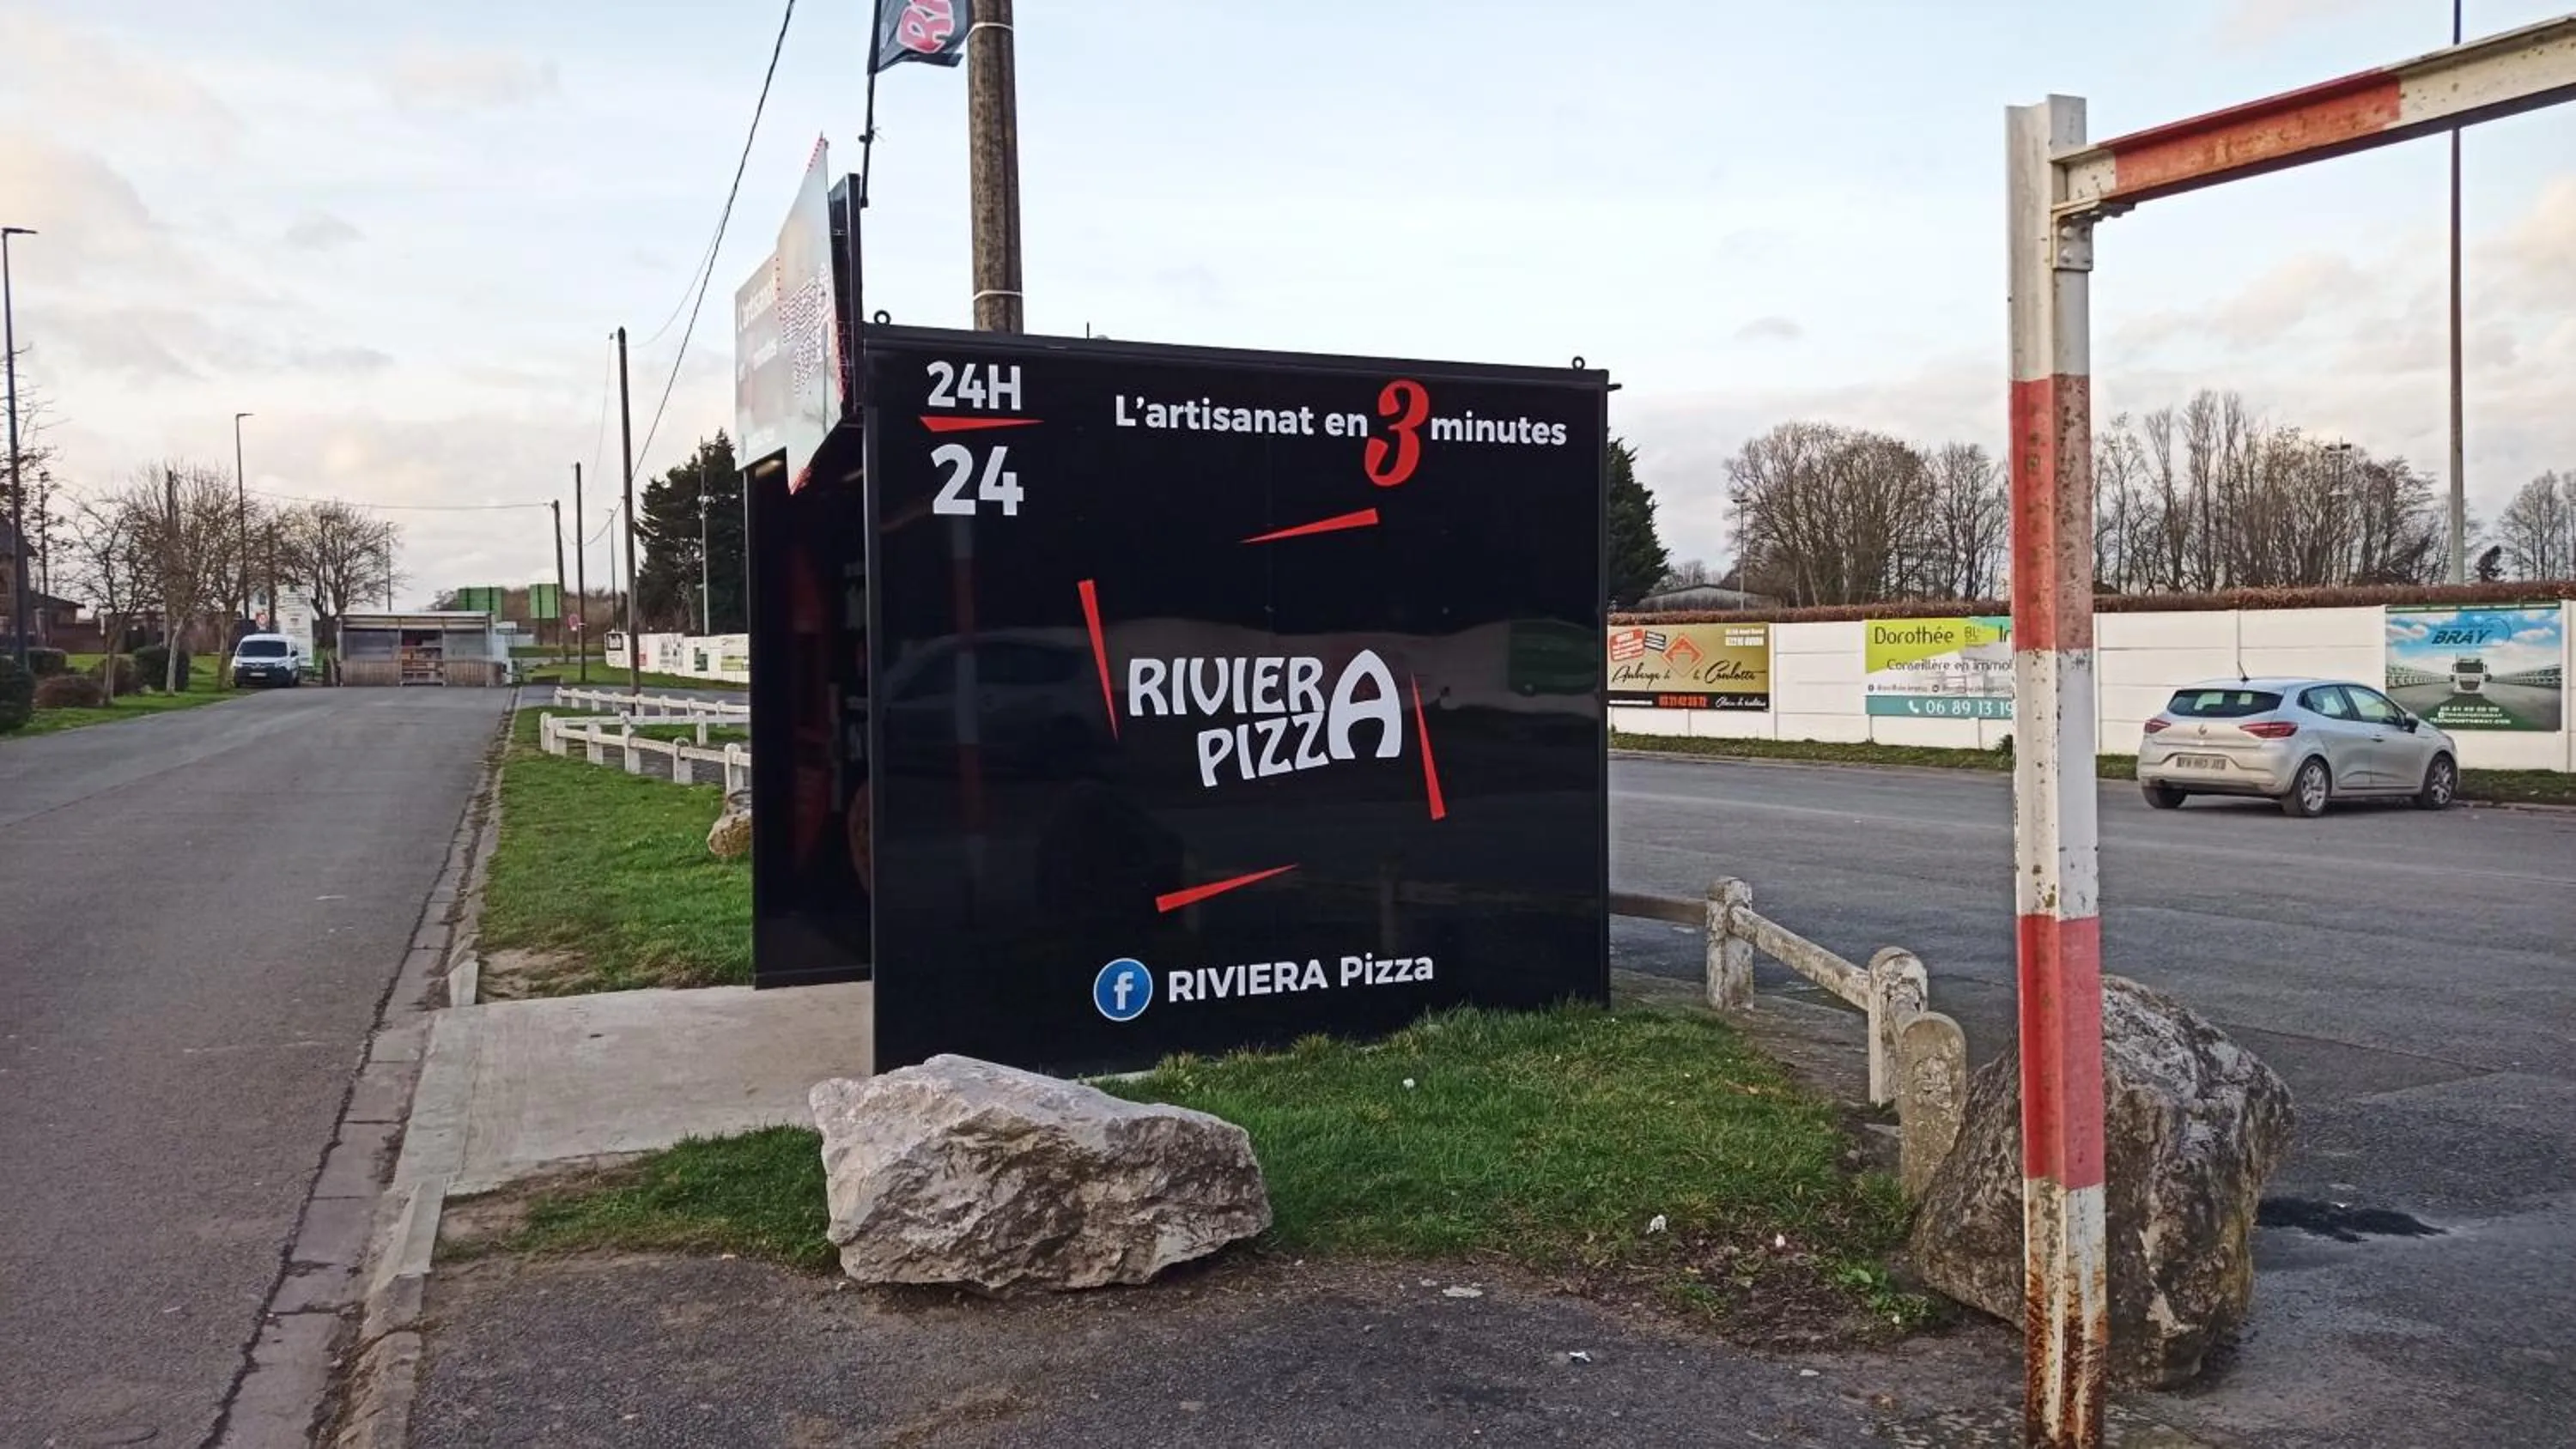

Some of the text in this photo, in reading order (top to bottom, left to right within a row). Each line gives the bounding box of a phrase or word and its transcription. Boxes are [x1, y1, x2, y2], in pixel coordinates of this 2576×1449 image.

[927, 361, 1022, 411] 24H
[1115, 381, 1567, 486] L'artisanat en 3 minutes
[930, 443, 1024, 516] 24
[1874, 625, 1954, 645] Dorothée
[2431, 629, 2494, 644] BRAY
[1925, 700, 1946, 715] 06
[1952, 700, 1971, 715] 89
[1978, 700, 1993, 716] 13
[1169, 959, 1328, 1003] RIVIERA
[1340, 952, 1434, 987] Pizza
